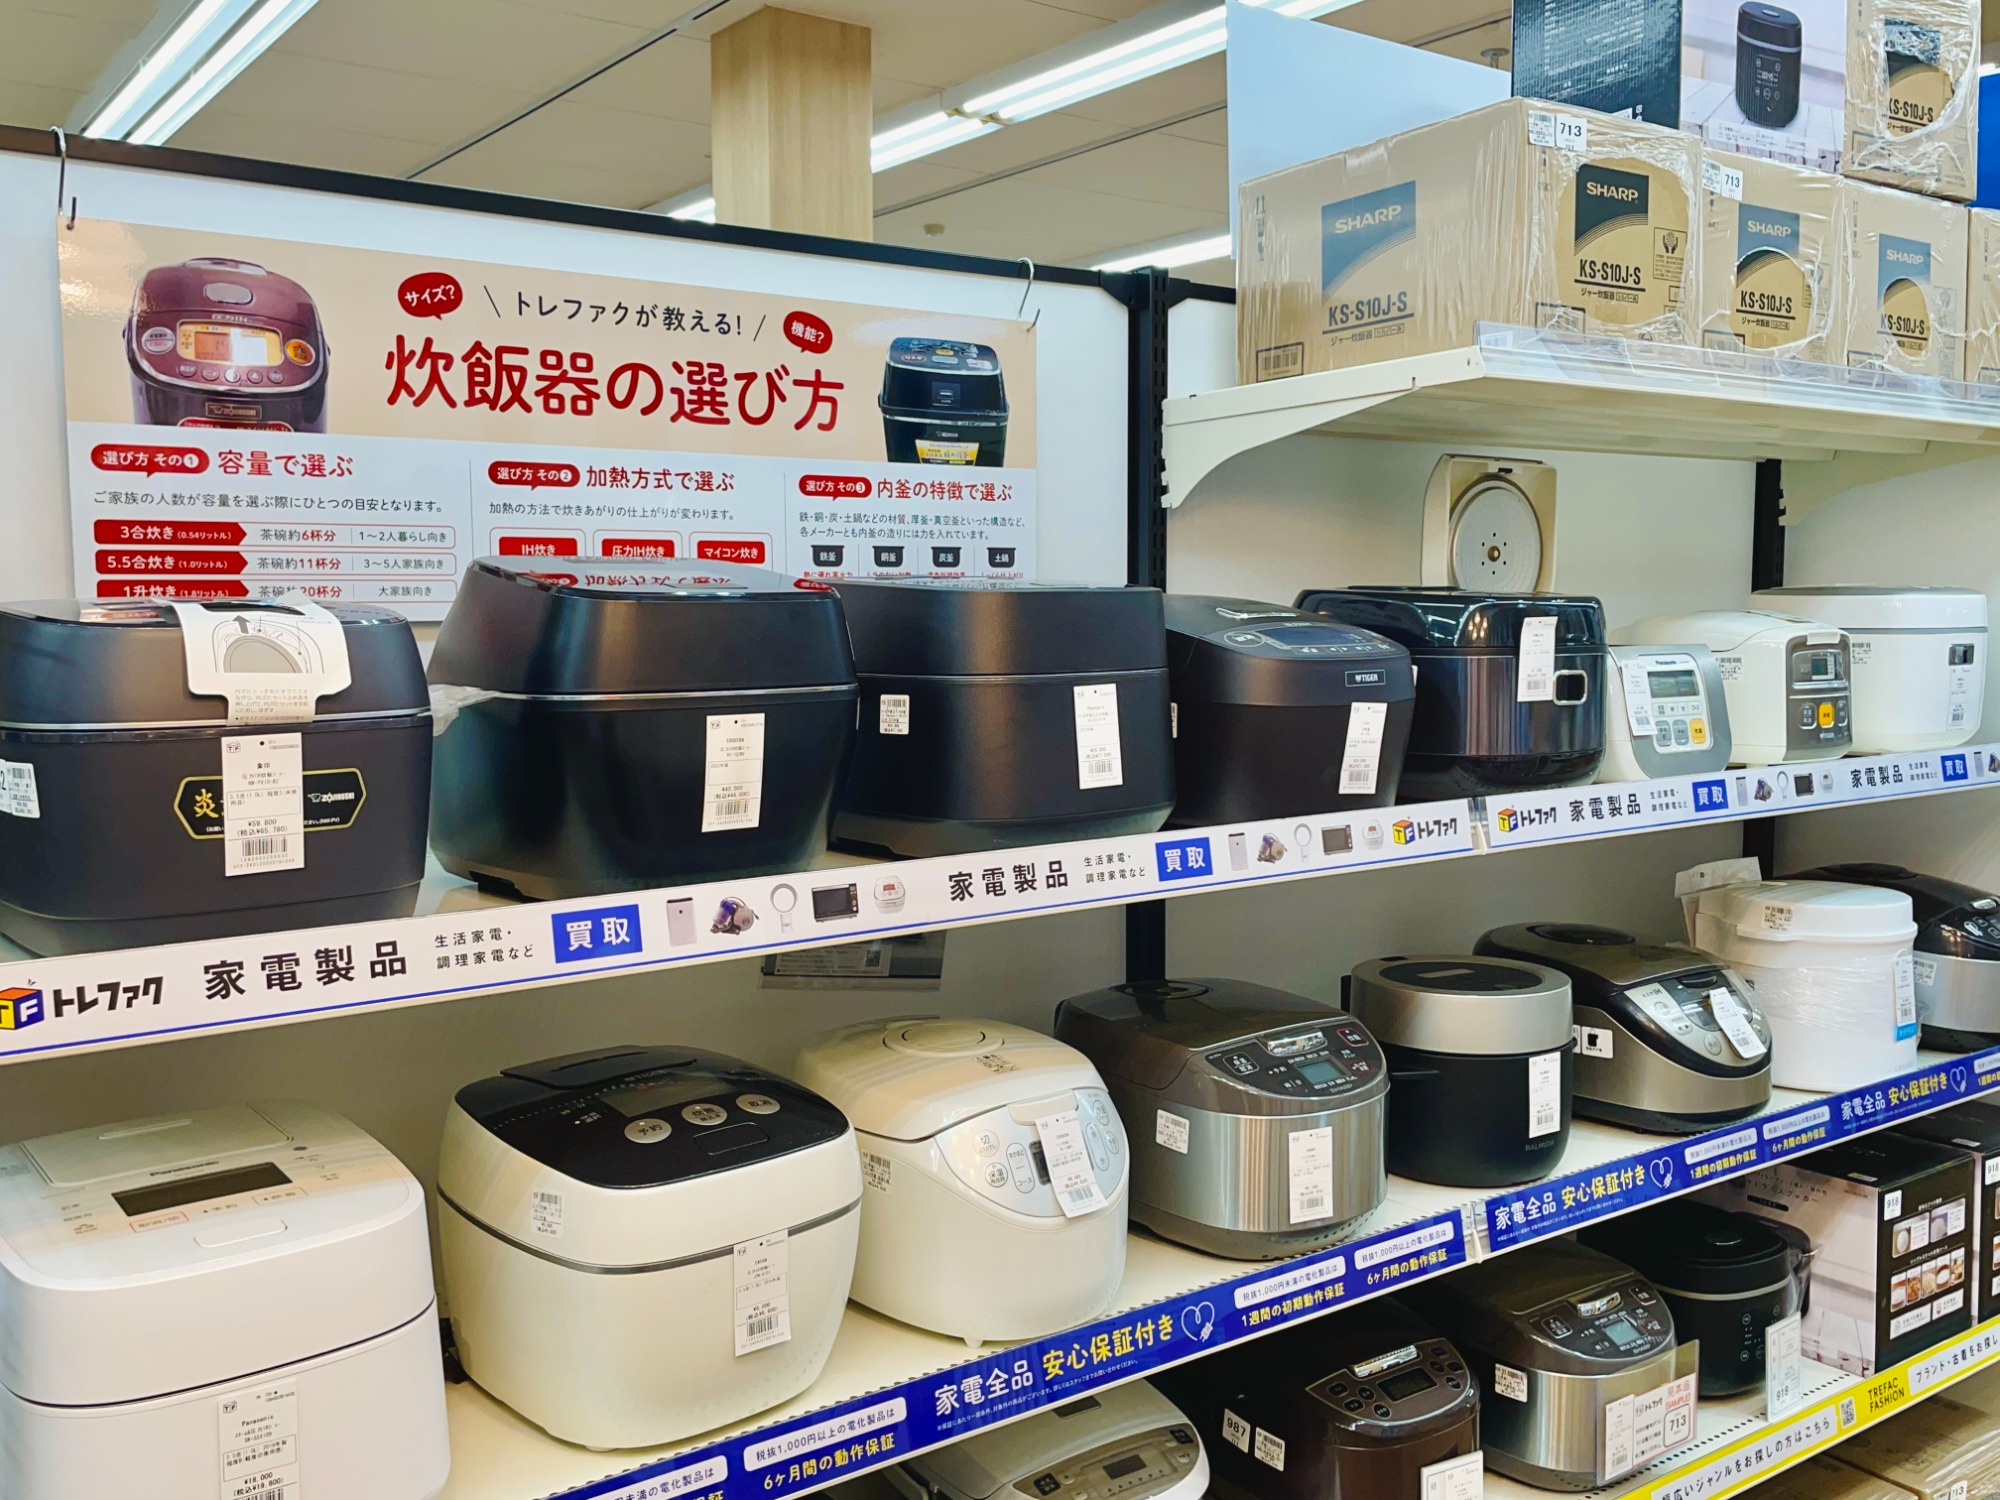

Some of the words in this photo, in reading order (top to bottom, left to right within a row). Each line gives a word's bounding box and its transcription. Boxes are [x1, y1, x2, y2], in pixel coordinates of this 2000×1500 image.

[1560, 122, 1582, 137] 713
[1586, 181, 1639, 203] SHARP
[1725, 174, 1740, 188] 713
[1334, 205, 1402, 235] SHARP
[1748, 220, 1791, 238] SHARP
[1886, 249, 1924, 265] SHARP
[1580, 258, 1642, 286] KS-S10J-S
[404, 284, 456, 308] サイズ?
[1740, 290, 1793, 313] KS-S10J-S
[514, 291, 743, 336] トレファクが教える!
[1328, 291, 1408, 327] KS-S10J-S
[789, 319, 826, 345] 機能?
[384, 333, 845, 433] 炊飯器の選び方
[102, 450, 150, 468] 選び方
[216, 449, 354, 479] 容量で選ぶ
[586, 465, 735, 492] 加熱方式で選ぶ
[876, 478, 1013, 502] 内釜の特徴で選ぶ
[92, 489, 443, 514] ご家族の人数が容量を選ぶ際にひとつの目安となります。
[489, 502, 734, 521] 加熱の方法で炊きあがりの仕上がりが変わります。
[120, 525, 175, 540] 3合炊き
[259, 528, 337, 543] 茶碗約6杯分
[521, 543, 556, 556] IH炊き
[612, 545, 665, 558] 圧力IH炊き
[703, 546, 759, 559] マイコン炊き
[106, 555, 175, 571] 5.5合炊き
[256, 557, 342, 572] 茶碗約11杯分
[378, 584, 433, 597] 大家族向き
[1361, 673, 1379, 683] TIGER
[1850, 764, 1903, 789] 家電製品
[1944, 760, 1965, 777] 買取
[1697, 785, 1724, 806] 買取
[1520, 806, 1557, 828] トレファク
[1569, 793, 1641, 823] 家電製品
[1417, 817, 1457, 839] トレファク
[1164, 846, 1208, 875] 買取
[948, 859, 1070, 902] 家電製品
[1085, 865, 1147, 884] 調理家電など
[567, 917, 632, 953] 買取
[436, 945, 535, 970] 調理家電など
[203, 940, 408, 1001] 家電製品
[53, 976, 164, 1018] トレファク
[1841, 1090, 1886, 1121] 家電全品
[1888, 1071, 1947, 1107] 安心保証付き
[1525, 1140, 1556, 1152] BALMUDA
[149, 1160, 220, 1178] Panasonic
[1495, 1192, 1557, 1230] 家電全品
[1561, 1163, 1647, 1210] 安心保証付き
[1886, 1197, 1899, 1208] 918
[1241, 1282, 1345, 1328] 1週間の初期動作保証
[935, 1359, 1034, 1417] 家電全品
[1042, 1314, 1174, 1381] 安心保証付き
[1868, 1377, 1899, 1401] TREFAC
[1869, 1387, 1905, 1413] FASHION
[242, 1415, 274, 1427] Panasonic
[1226, 1417, 1247, 1438] 987
[1669, 1414, 1687, 1432] 713
